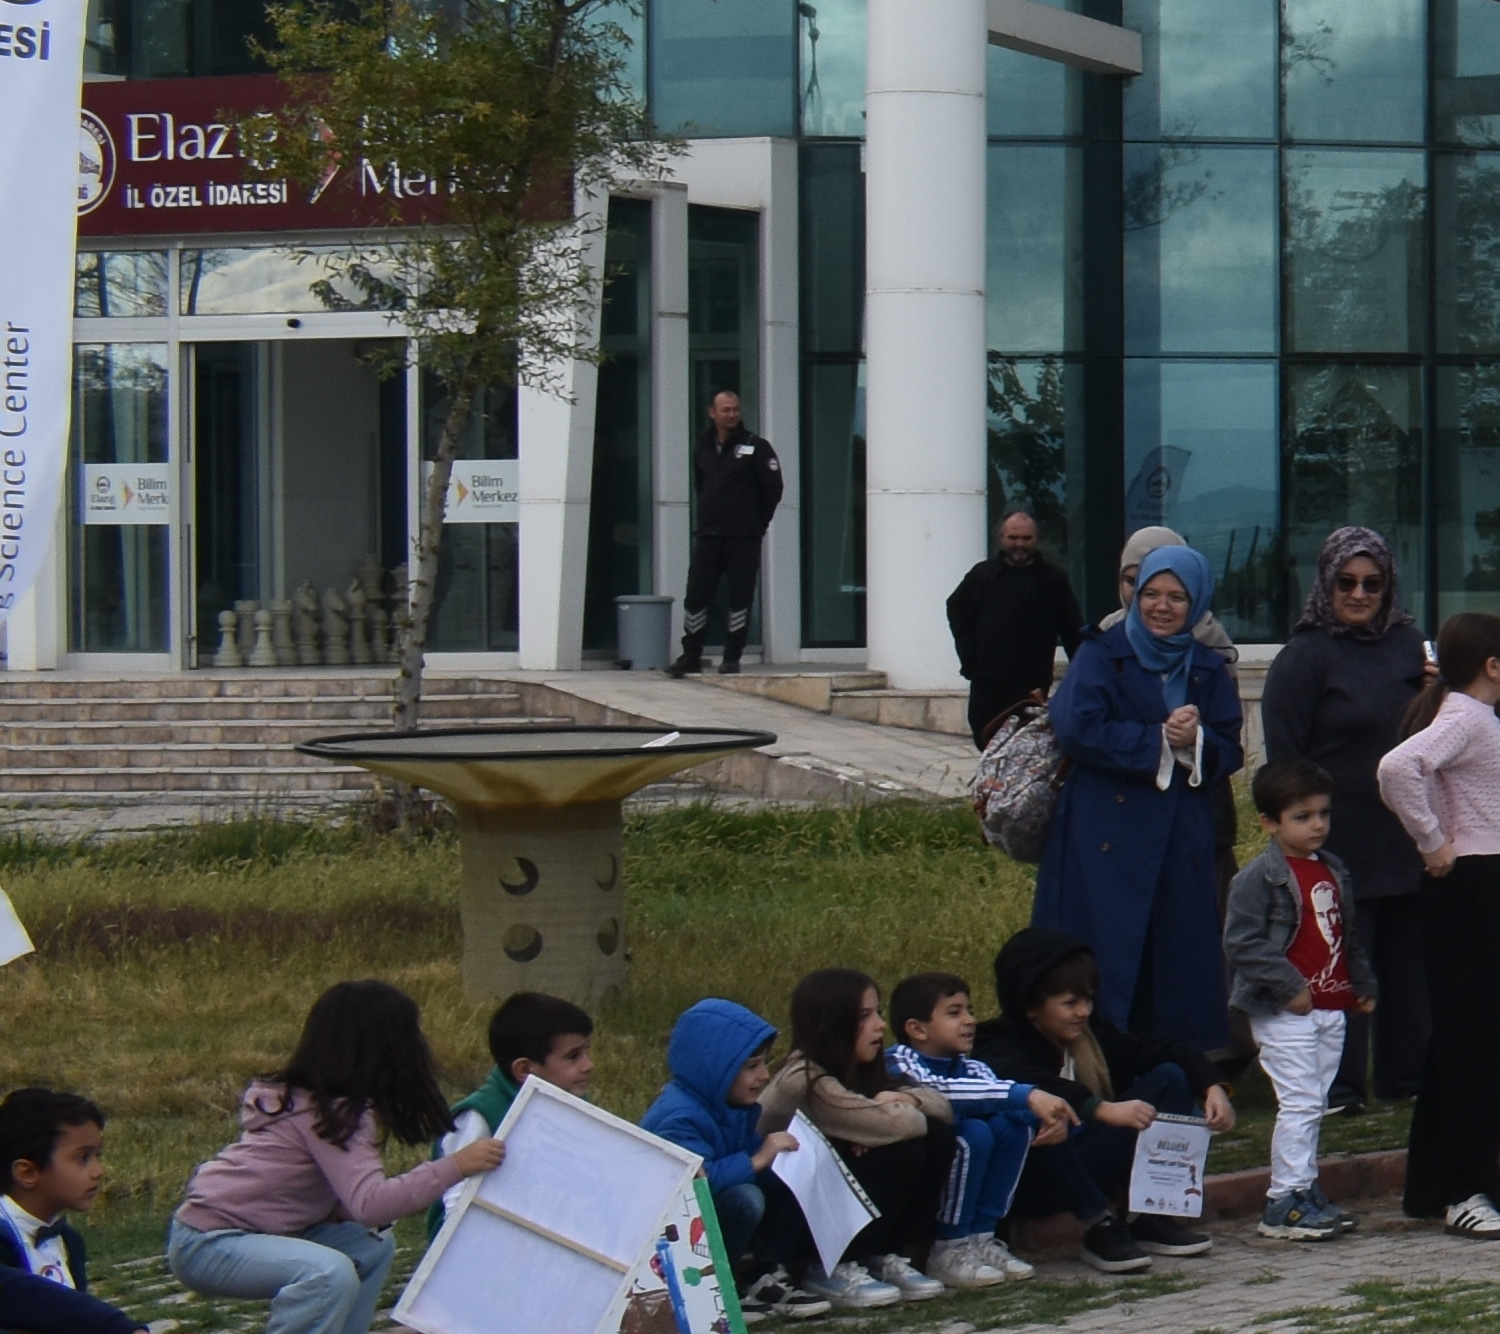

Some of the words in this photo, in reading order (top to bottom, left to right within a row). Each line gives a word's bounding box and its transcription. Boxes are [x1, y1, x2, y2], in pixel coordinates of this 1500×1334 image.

[127, 185, 145, 208] İL
[151, 183, 202, 208] ÖZEL
[209, 178, 287, 206] İDARESİ
[0, 321, 30, 438] Center
[138, 478, 167, 490] Bilim
[472, 475, 503, 488] Bilim
[0, 449, 25, 582] Science
